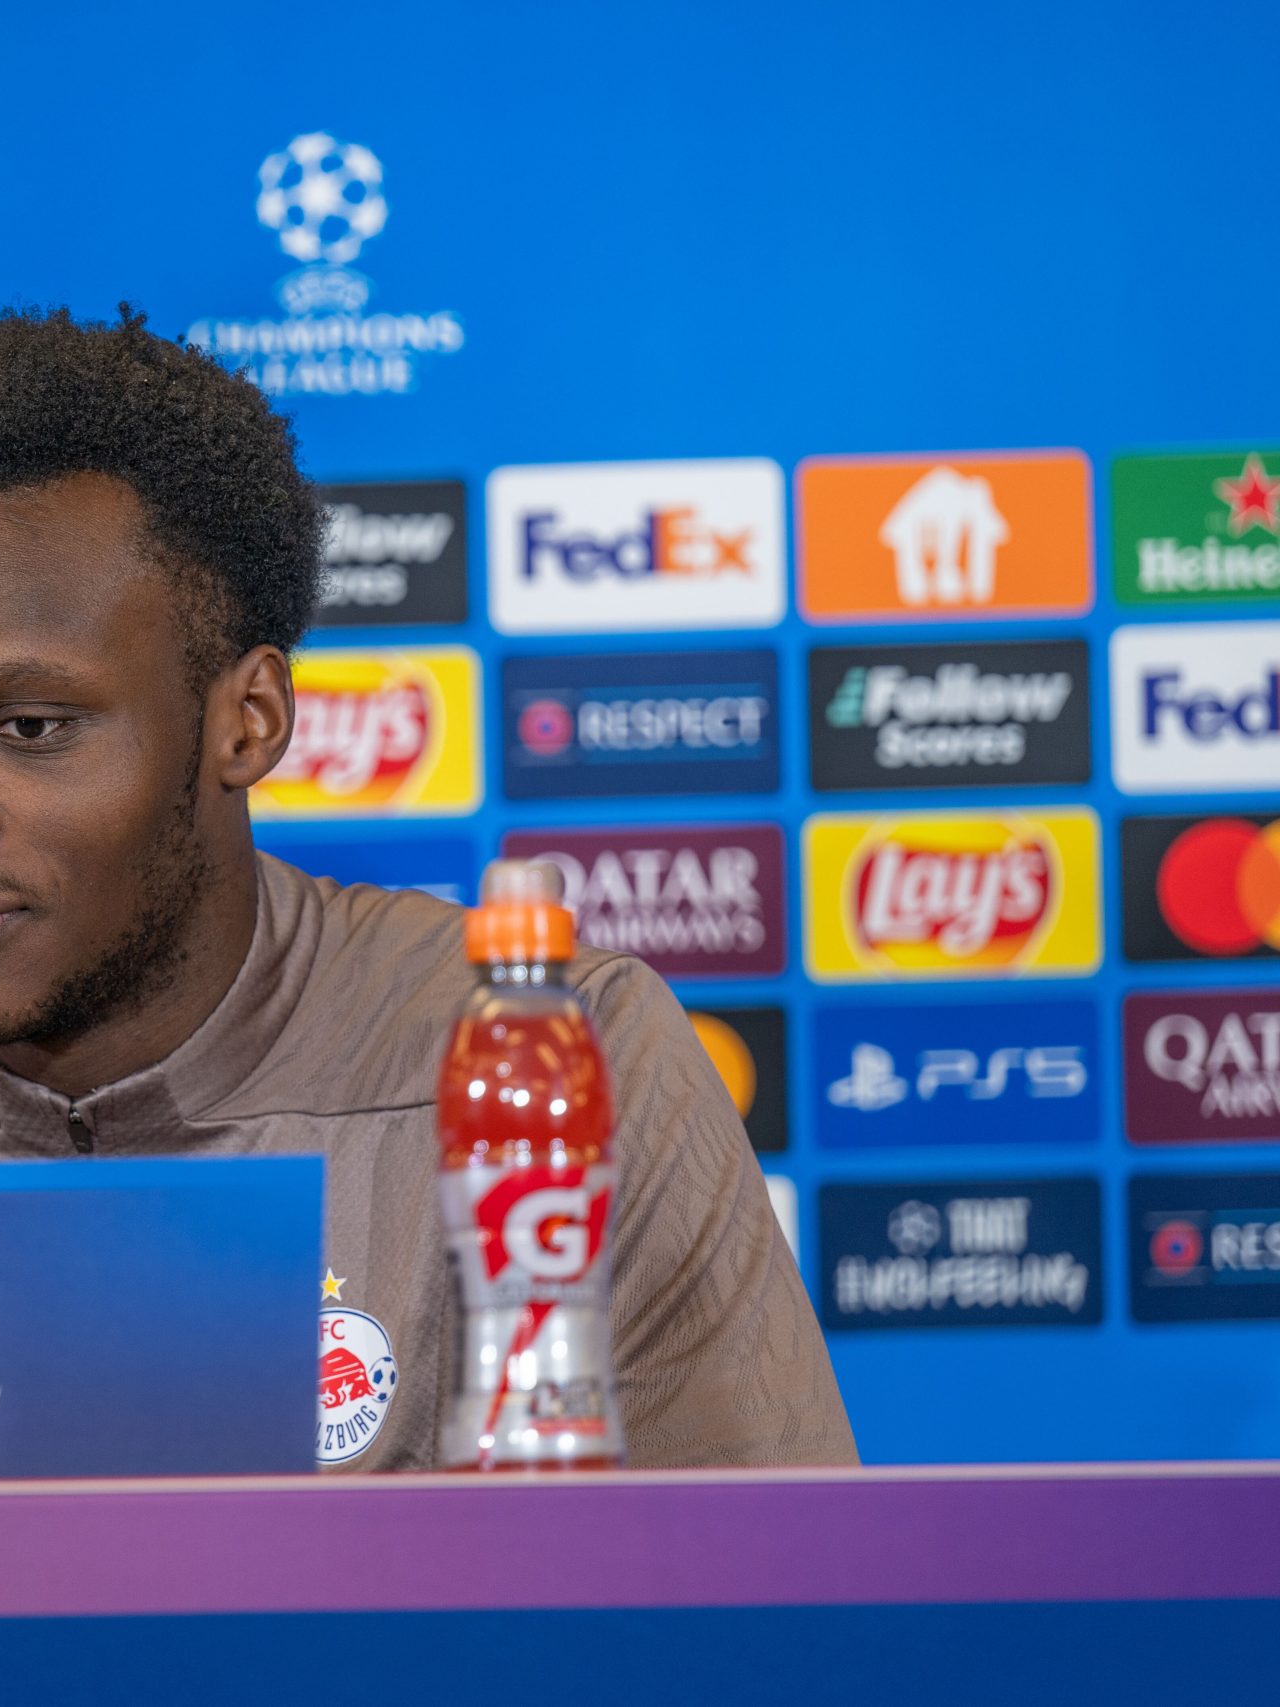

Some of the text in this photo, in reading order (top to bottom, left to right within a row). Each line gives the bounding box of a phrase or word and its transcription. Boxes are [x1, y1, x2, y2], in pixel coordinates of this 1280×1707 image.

[519, 509, 754, 581] FedEx
[862, 664, 1071, 726] Follow
[578, 698, 766, 750] RESPECT
[876, 724, 1024, 767] Scores
[918, 1047, 1086, 1099] PS5
[502, 1186, 590, 1278] G
[319, 1319, 345, 1341] FC
